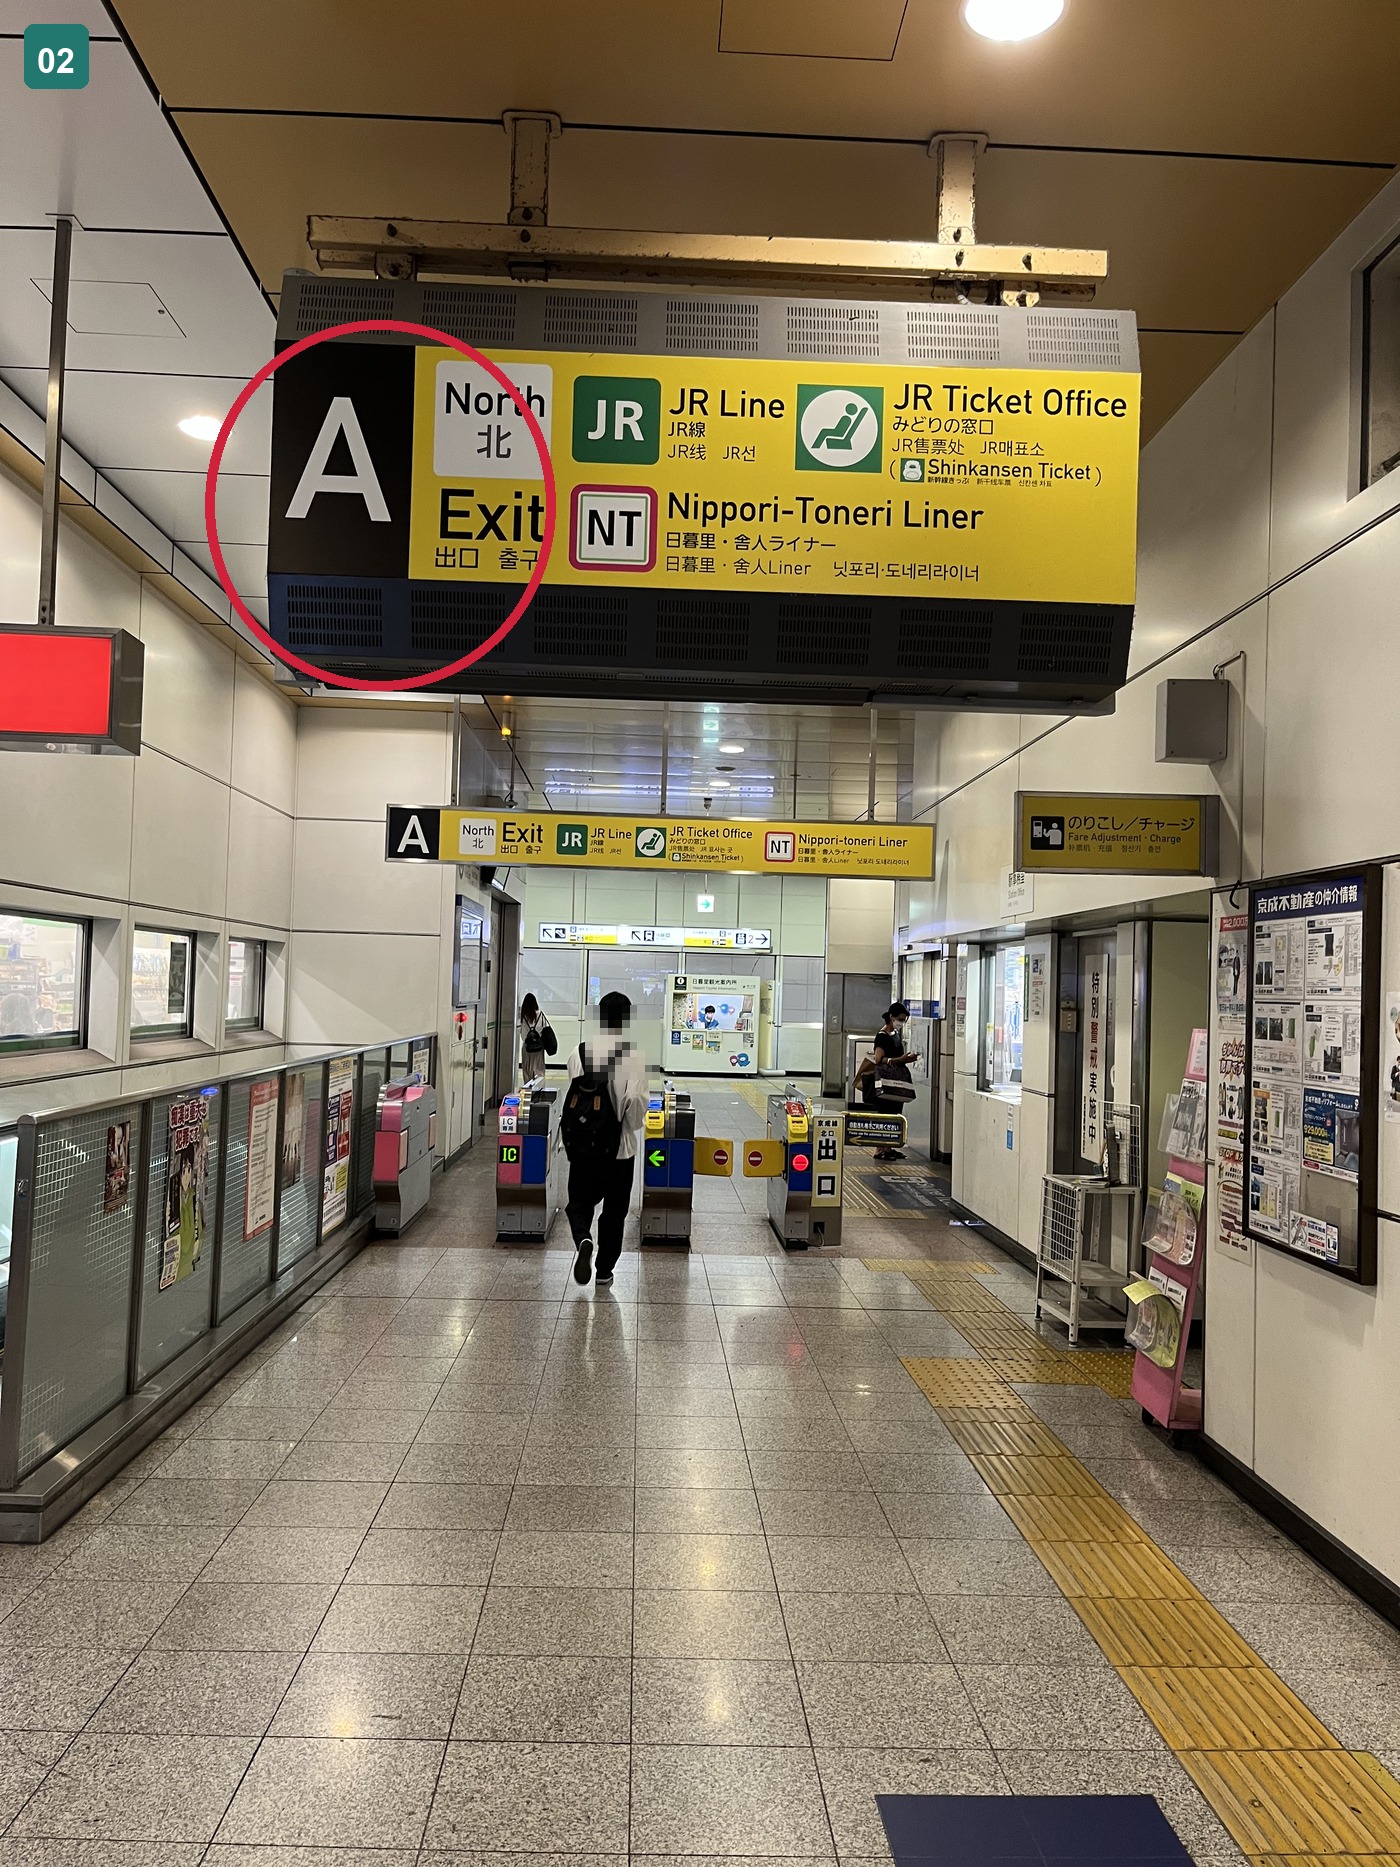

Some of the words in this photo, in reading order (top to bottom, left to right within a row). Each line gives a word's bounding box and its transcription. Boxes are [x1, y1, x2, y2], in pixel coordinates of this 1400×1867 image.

[669, 388, 709, 416] JR
[720, 390, 785, 418] Line
[893, 383, 933, 411] JR
[942, 385, 1033, 414] Ticket
[1043, 388, 1127, 418] Office
[588, 400, 644, 441] JR
[892, 416, 994, 435] みどりの窓口
[668, 422, 706, 439] JR線
[477, 425, 512, 459] 北
[891, 438, 965, 456] JR售票处
[980, 440, 1045, 457] JR매표소
[285, 396, 391, 522] A
[667, 444, 707, 461] JR线
[722, 445, 756, 462] JR선
[928, 458, 1032, 478] Shinkansen
[1038, 462, 1091, 481] Ticket
[440, 488, 545, 543] Exit
[668, 492, 892, 528] Nippori-Toneri
[903, 500, 984, 530] Liner
[587, 509, 642, 547] NT
[435, 545, 479, 569] 出口
[499, 548, 539, 571] 출구
[397, 815, 430, 854] A
[462, 825, 494, 836] North
[502, 822, 543, 843] Exit
[591, 828, 605, 838] JR
[608, 829, 632, 839] Line
[670, 826, 684, 836] JR
[687, 827, 719, 837] Ticket
[722, 828, 753, 839] Office
[1068, 832, 1089, 841] Fare
[1091, 833, 1142, 843] Adjustment
[1150, 834, 1181, 844] Charge
[472, 838, 484, 849] 北
[562, 832, 582, 847] JR
[771, 840, 790, 854] NT
[799, 834, 876, 847] Nippori-toneri
[879, 836, 908, 847] Liner
[501, 845, 518, 854] 出口
[525, 845, 542, 854] 출구
[682, 852, 719, 860] Shinkansen
[1257, 884, 1359, 914] 京成不動産の仲介情報
[502, 1117, 514, 1125] IC
[502, 1147, 517, 1161] IC
[818, 1138, 837, 1195] 出口
